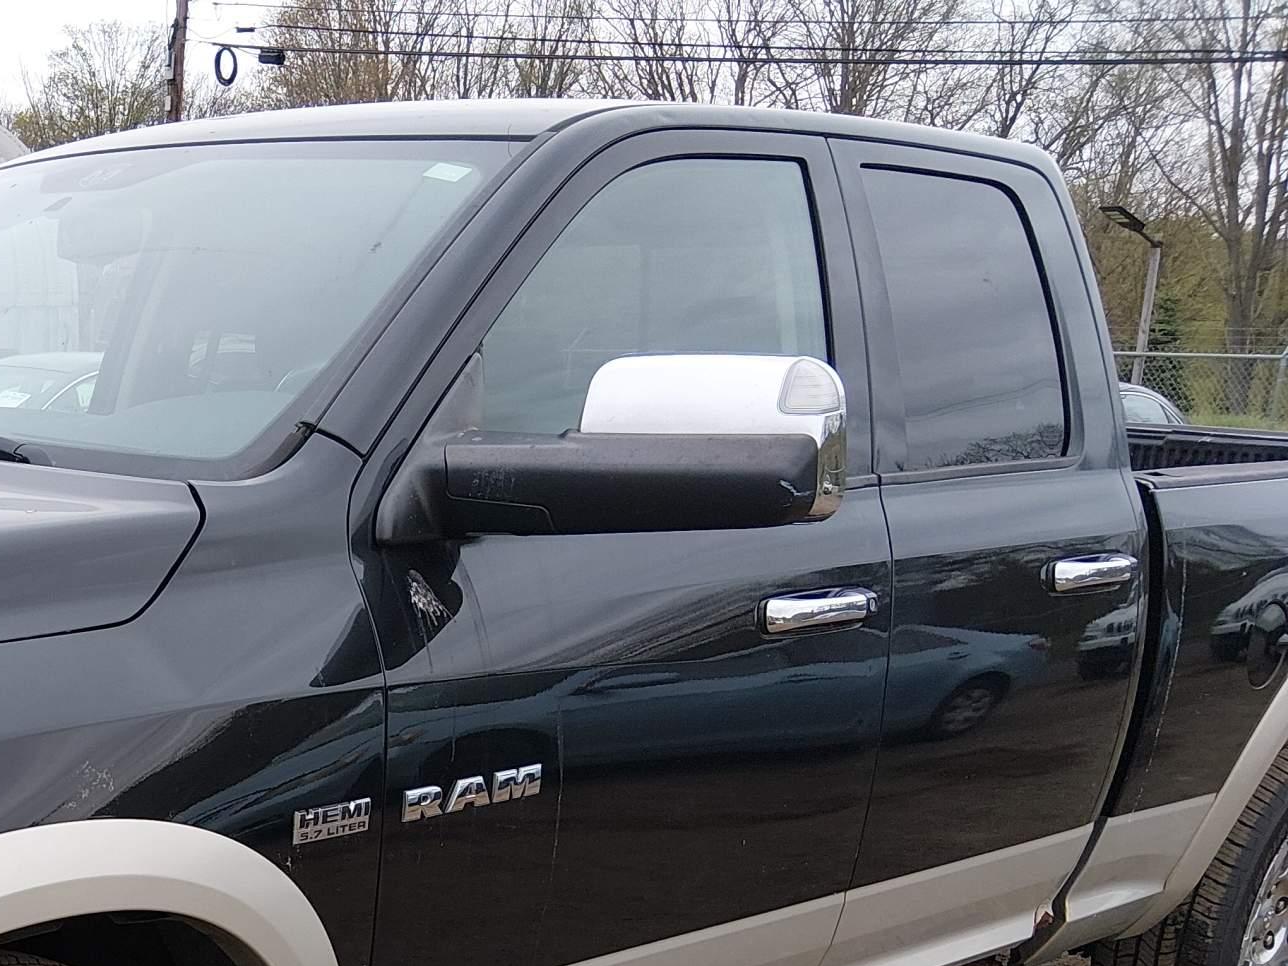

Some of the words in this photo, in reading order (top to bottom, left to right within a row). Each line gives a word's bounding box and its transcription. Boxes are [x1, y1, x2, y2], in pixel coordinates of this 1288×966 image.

[401, 763, 542, 823] RAM
[294, 797, 371, 830] HEMI
[299, 829, 323, 842] 5.7
[326, 820, 367, 837] LITER
